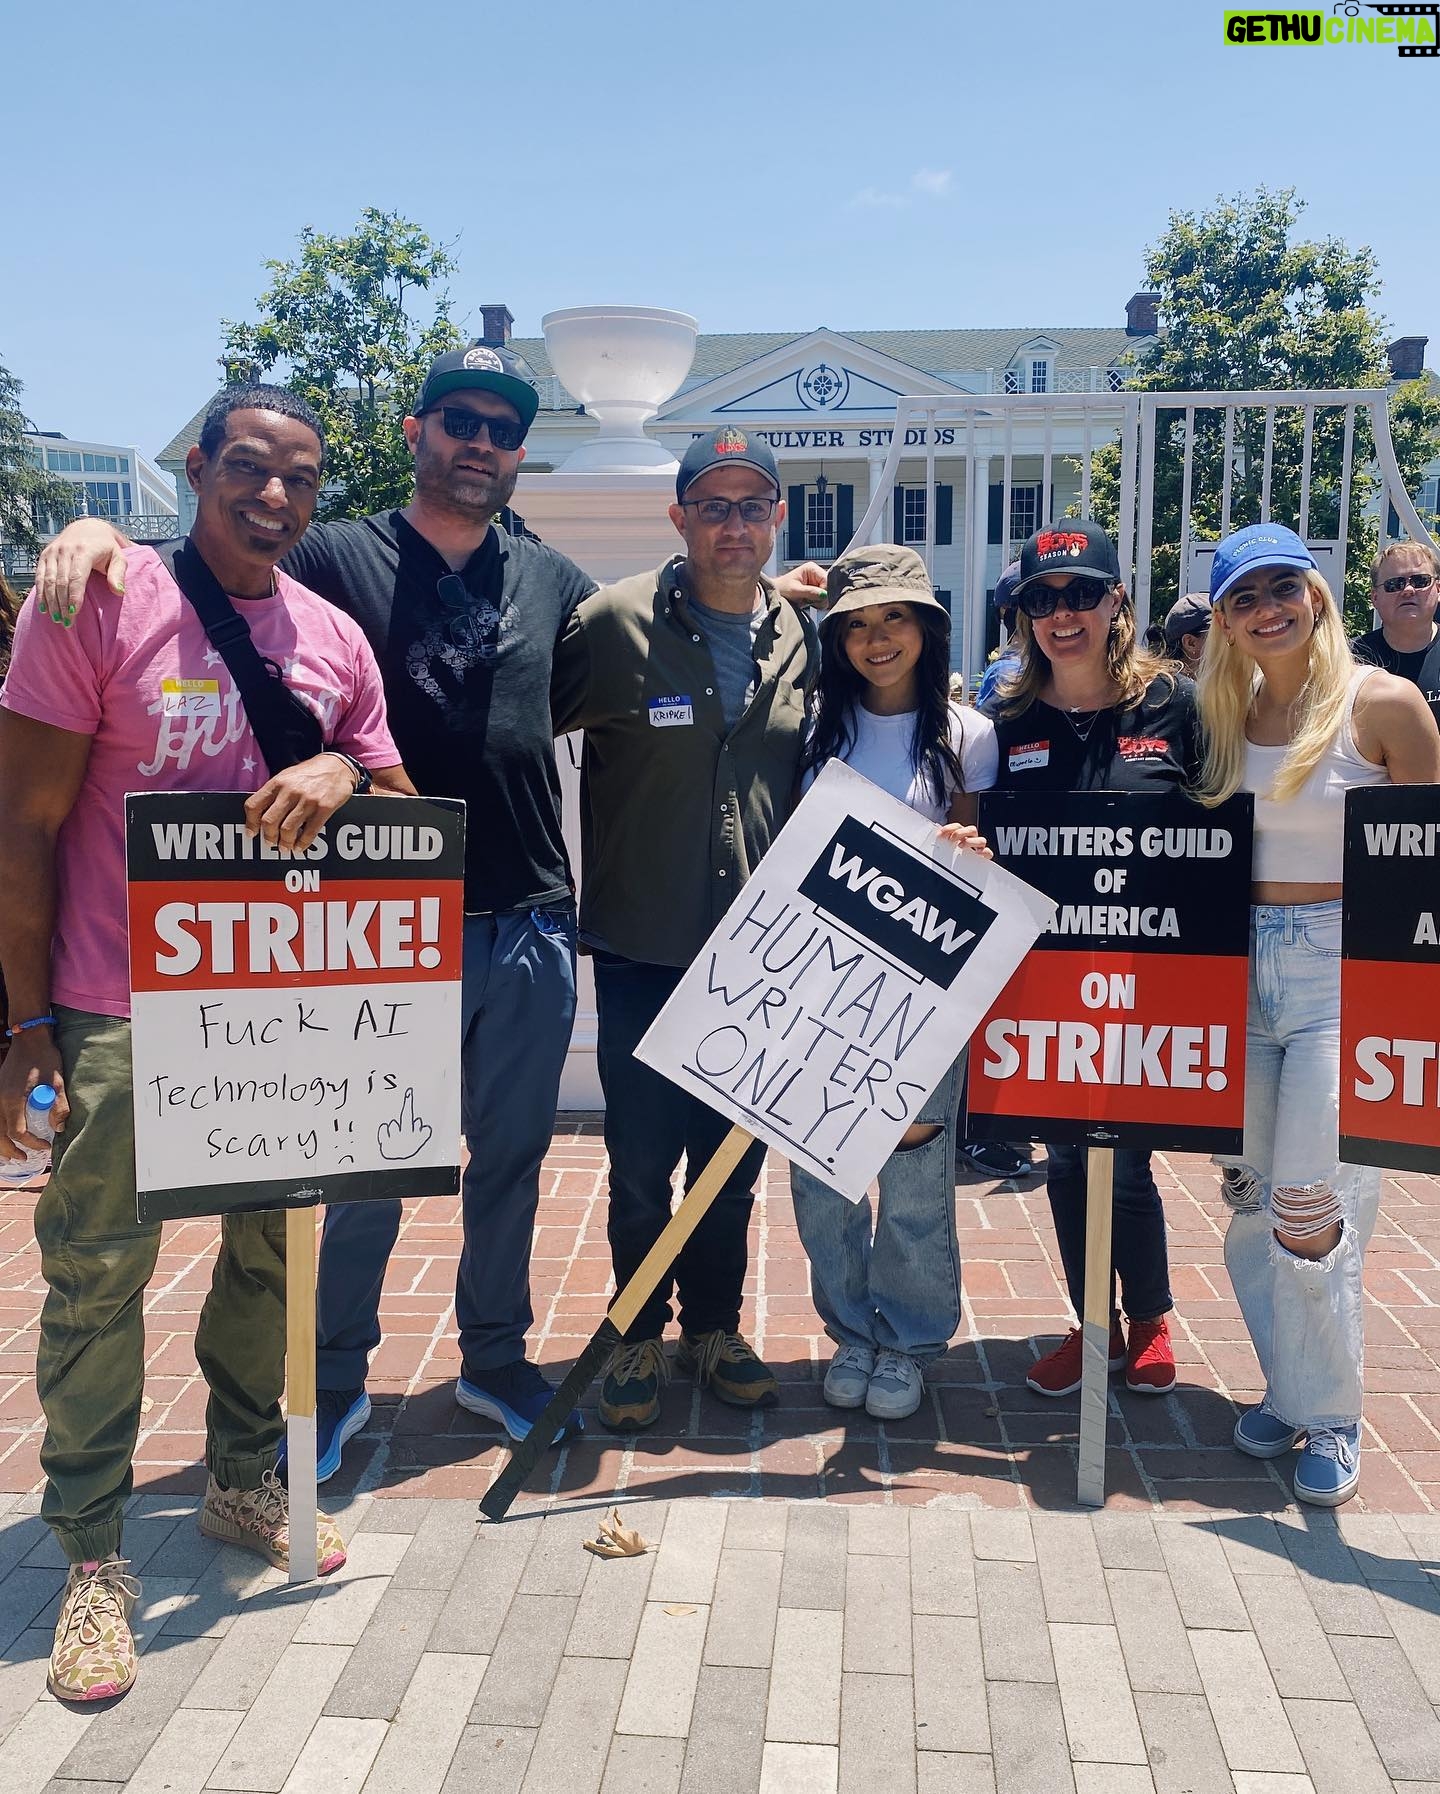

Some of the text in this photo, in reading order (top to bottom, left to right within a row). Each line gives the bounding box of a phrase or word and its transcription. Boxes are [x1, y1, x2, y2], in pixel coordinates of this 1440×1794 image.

[1040, 549, 1067, 561] SEASON
[1232, 536, 1278, 557] PICNIC CLUB
[175, 679, 204, 688] HELLO
[166, 695, 214, 711] LAZ
[1018, 742, 1040, 751] HELLO
[336, 826, 443, 860] GUILD
[995, 826, 1233, 858] WRITERS GUILD
[1363, 823, 1440, 856] WRI
[285, 869, 320, 893] ON
[1094, 868, 1127, 894] OF
[826, 841, 976, 955] WGAW
[154, 897, 441, 976] STRIKE!
[729, 889, 936, 1061] HUMAN
[1080, 972, 1136, 1010] ON
[199, 999, 413, 1049] Fuck AI
[708, 952, 927, 1122] WRITERS
[983, 1018, 1229, 1092] STRIKE!
[367, 1069, 398, 1094] is
[1354, 1036, 1440, 1108] ST
[695, 1025, 868, 1164] ONLY!
